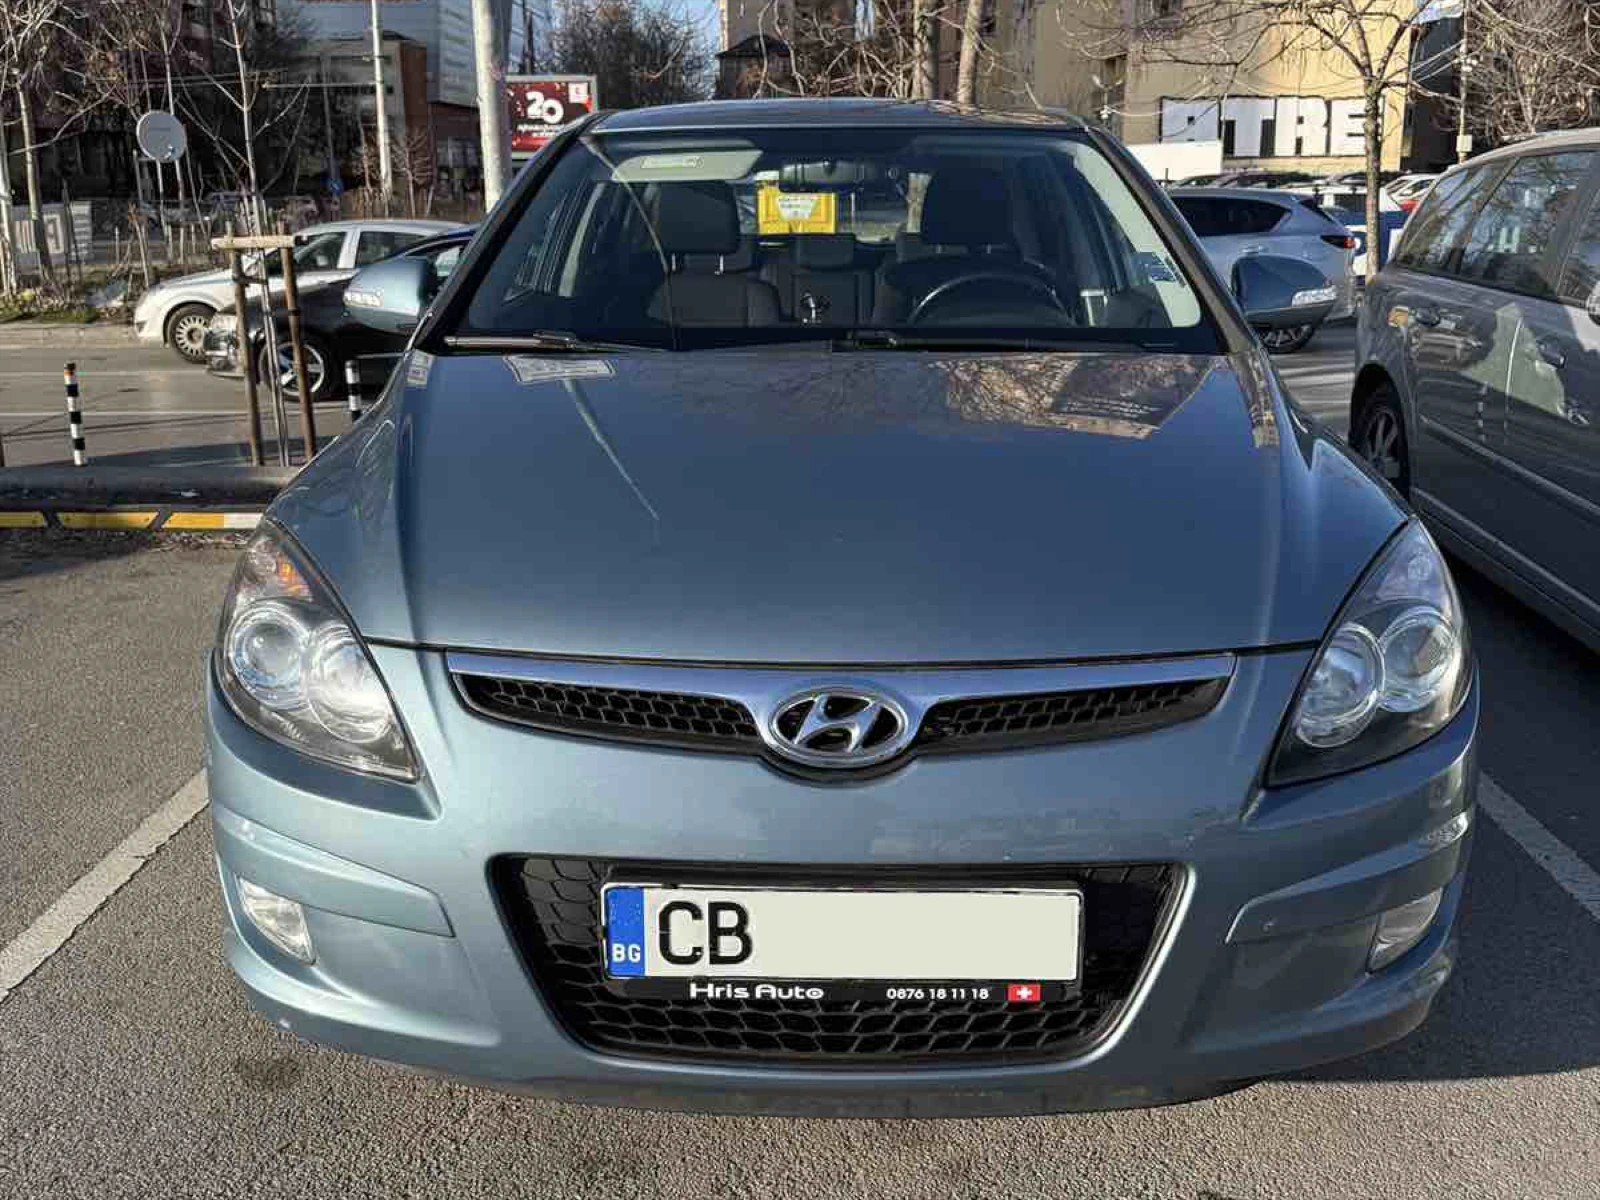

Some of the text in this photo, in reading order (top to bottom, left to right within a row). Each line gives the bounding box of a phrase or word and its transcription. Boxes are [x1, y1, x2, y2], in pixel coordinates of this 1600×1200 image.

[526, 91, 564, 124] 20
[658, 900, 753, 965] CB
[612, 943, 641, 963] BG
[690, 983, 824, 999] Hris Auto
[886, 988, 989, 999] 0876 18 11 18
